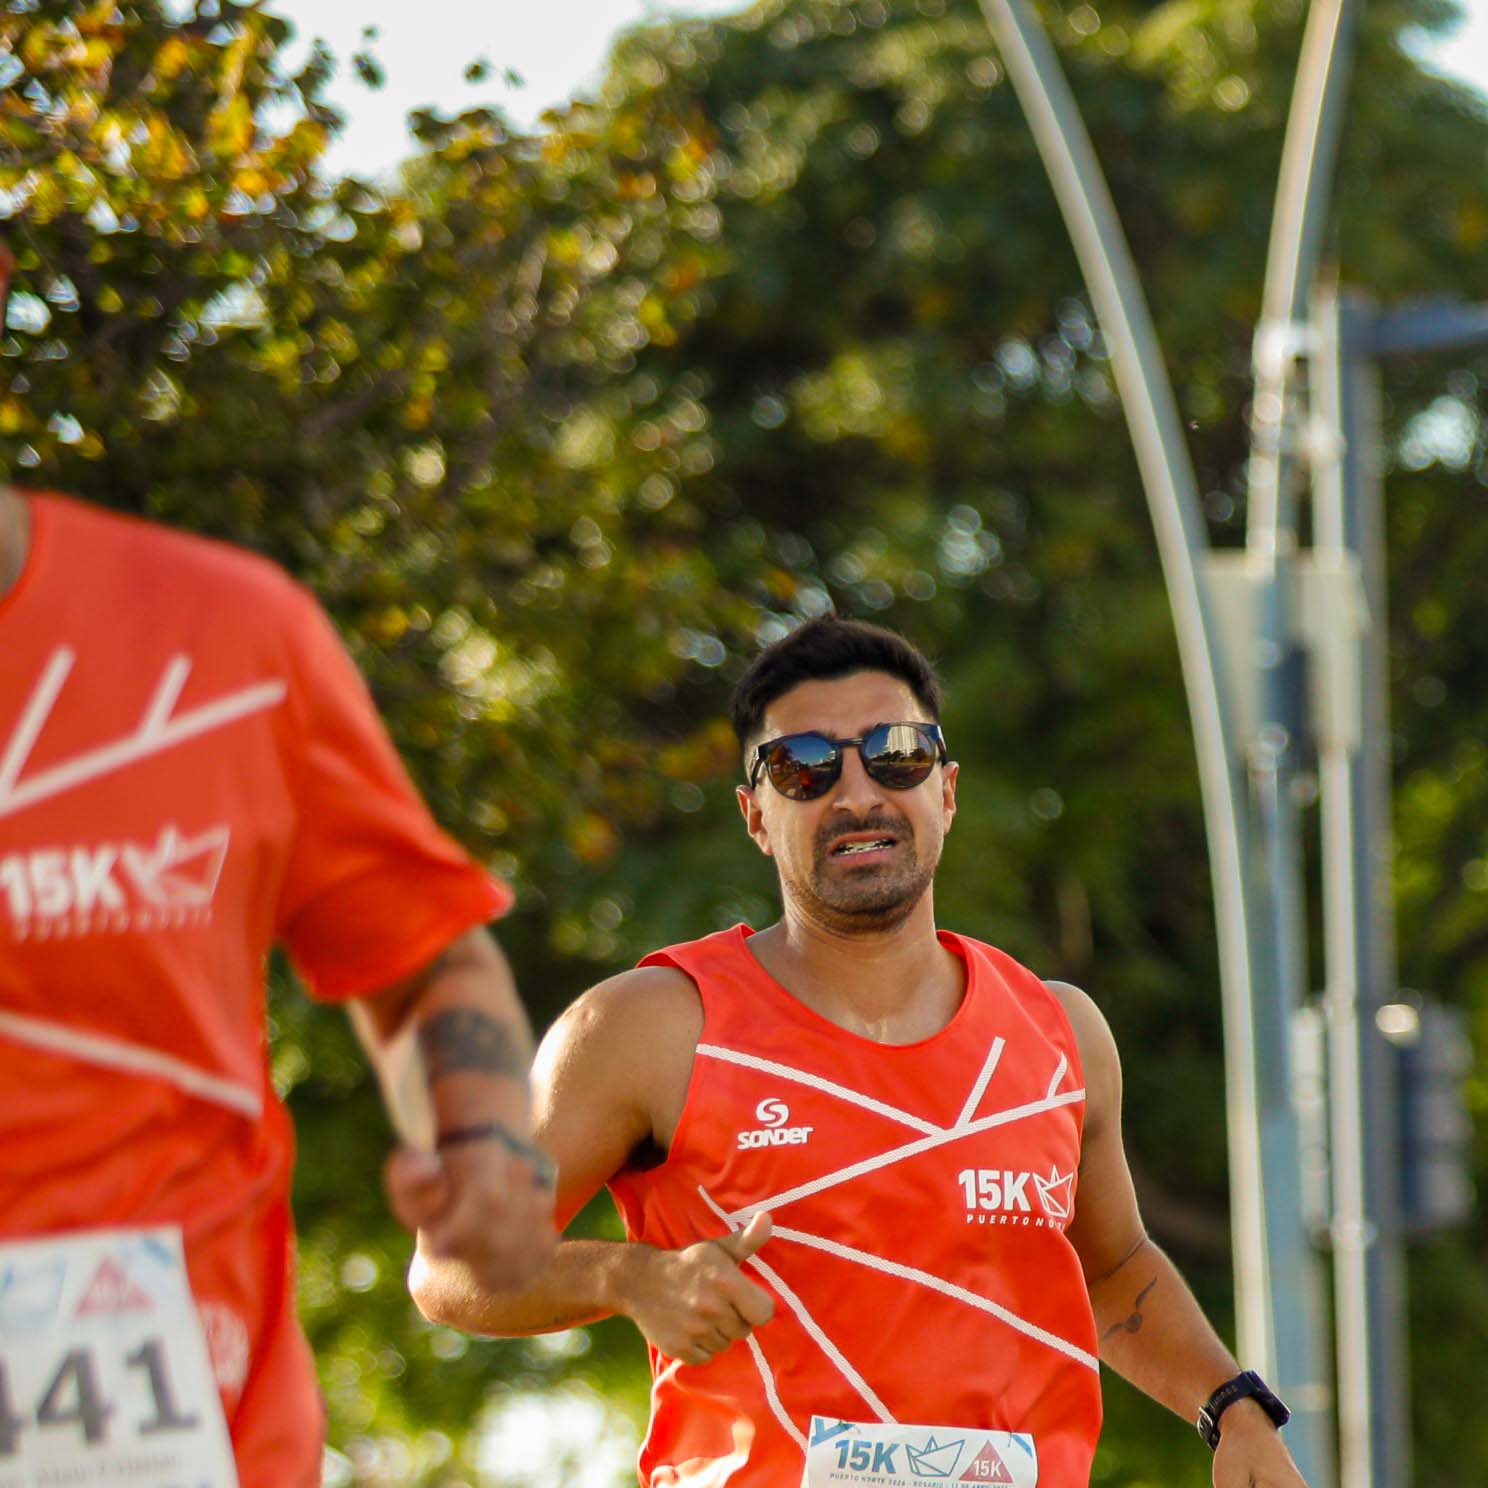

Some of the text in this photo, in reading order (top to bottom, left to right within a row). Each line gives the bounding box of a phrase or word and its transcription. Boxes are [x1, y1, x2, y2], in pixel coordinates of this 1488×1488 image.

[958, 1168, 1032, 1212] 15K
[966, 1213, 1030, 1226] PUERTO
[834, 1439, 900, 1474] 15K
[973, 1459, 1002, 1477] 15K
